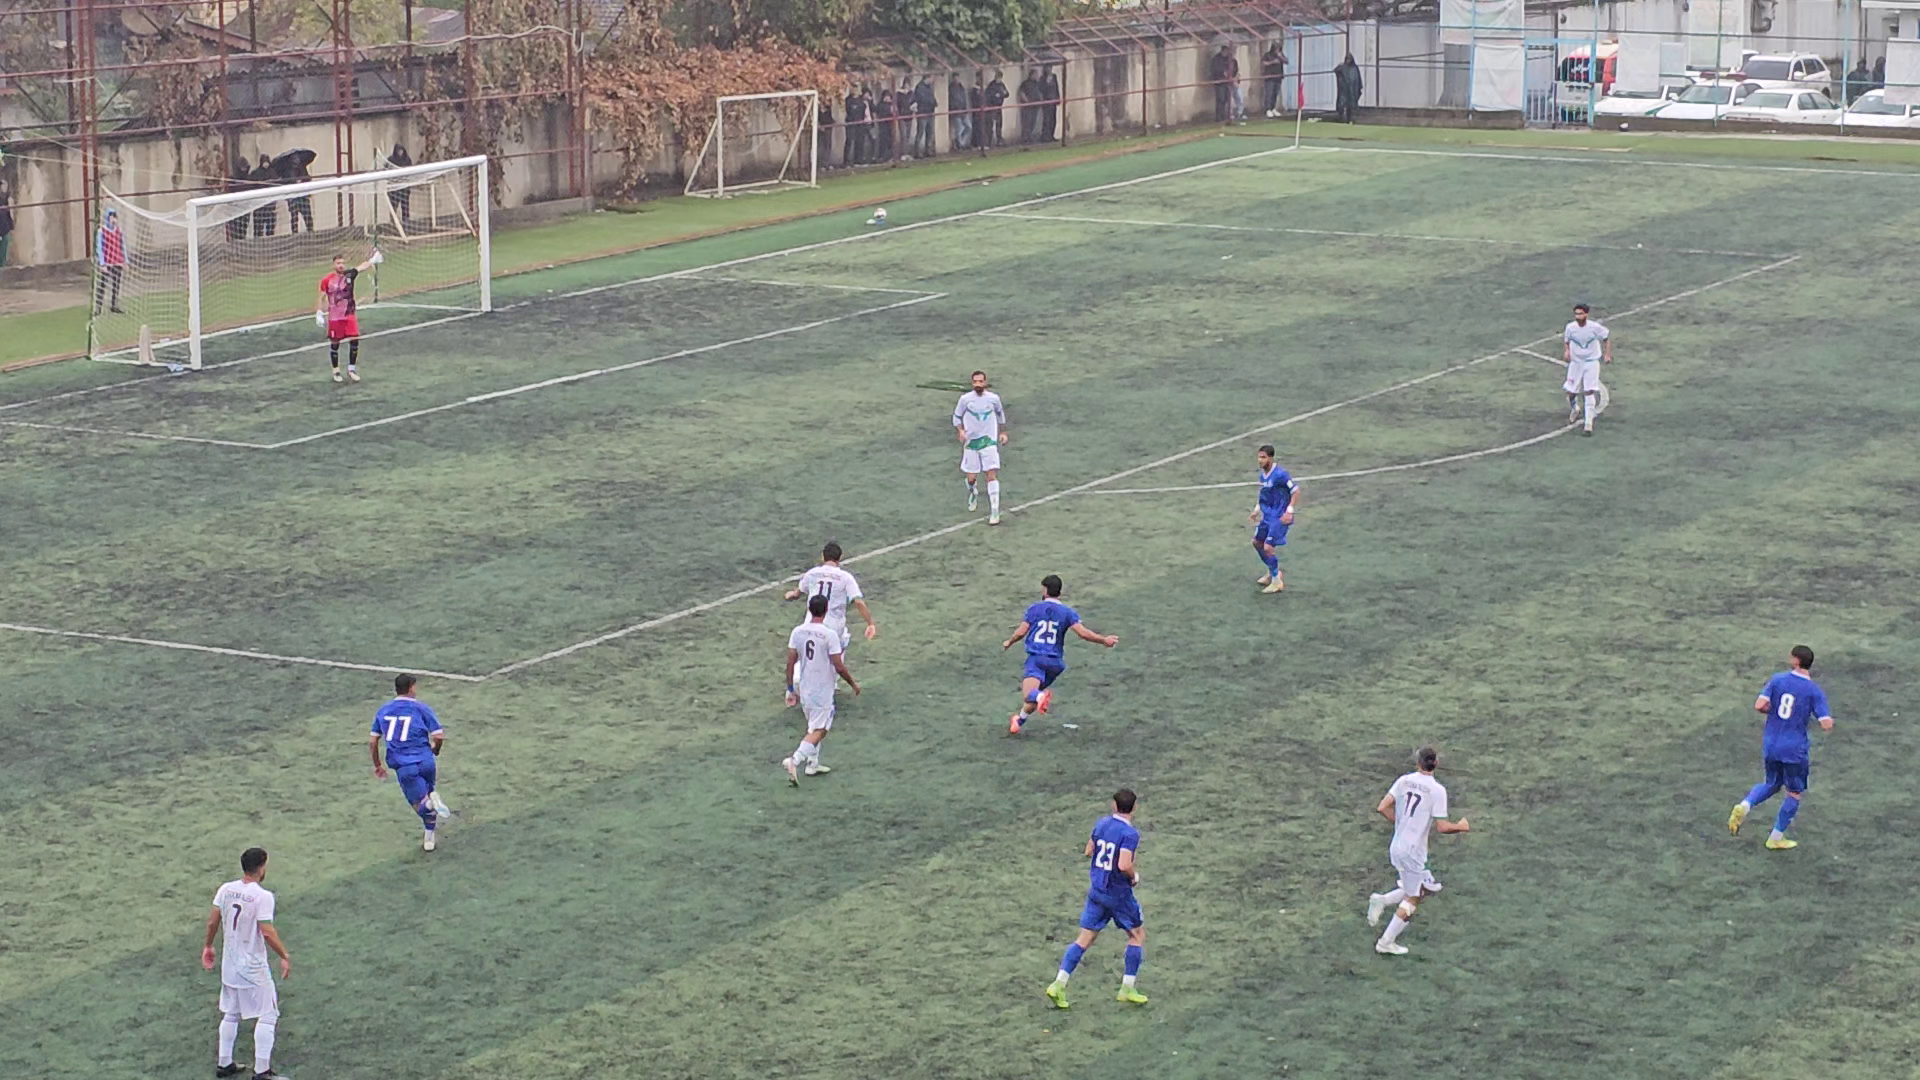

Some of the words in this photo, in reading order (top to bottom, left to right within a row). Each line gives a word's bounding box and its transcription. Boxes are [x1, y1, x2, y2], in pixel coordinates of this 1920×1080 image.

[818, 581, 833, 600] 11
[1034, 619, 1059, 644] 25
[806, 640, 815, 660] 6
[1778, 693, 1794, 719] 8
[383, 715, 412, 742] 77
[1404, 792, 1421, 817] 17
[1096, 839, 1116, 871] 23
[232, 904, 242, 931] 7
